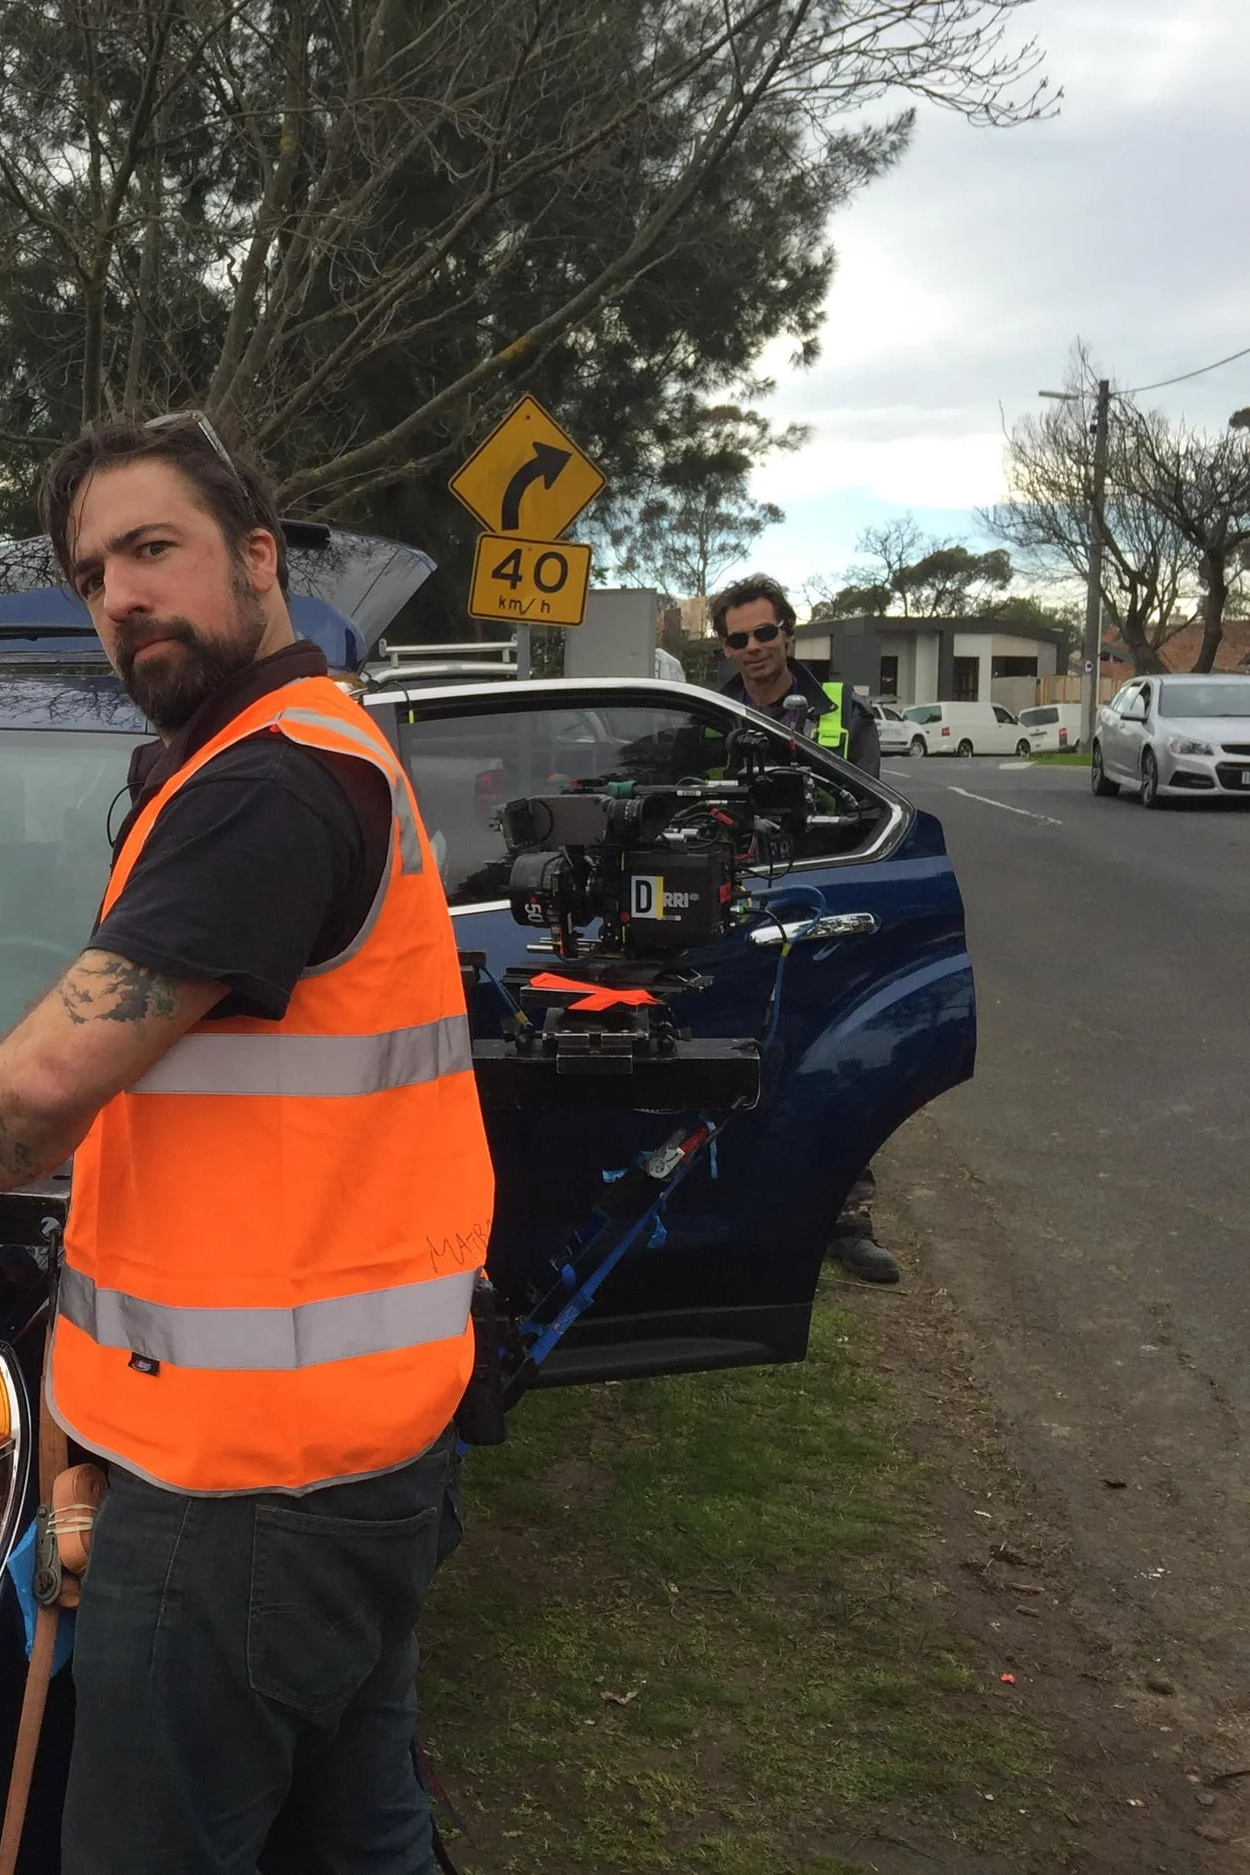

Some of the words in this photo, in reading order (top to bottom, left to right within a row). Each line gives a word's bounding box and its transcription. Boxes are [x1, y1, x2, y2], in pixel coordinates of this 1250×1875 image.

[491, 547, 568, 594] 40
[498, 594, 551, 616] km/h
[635, 880, 653, 913] D
[662, 892, 689, 908] RRI
[524, 903, 544, 923] 50
